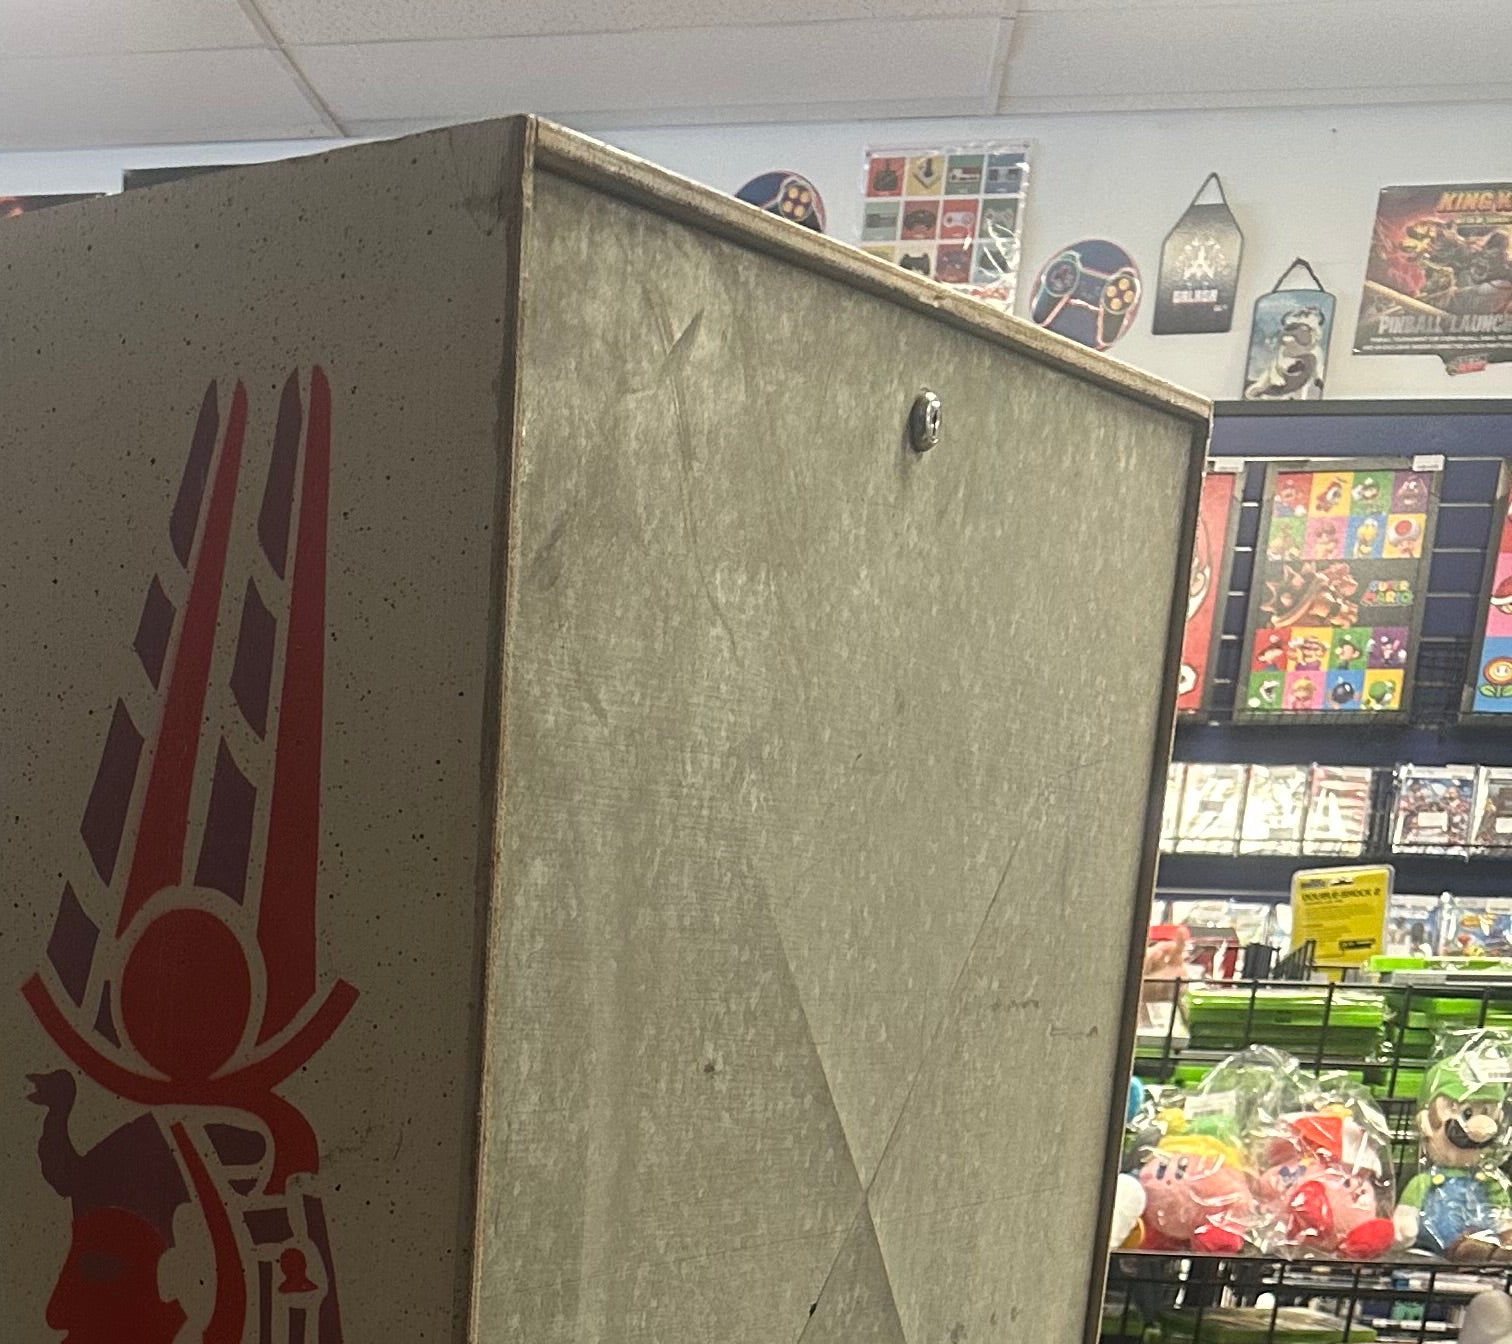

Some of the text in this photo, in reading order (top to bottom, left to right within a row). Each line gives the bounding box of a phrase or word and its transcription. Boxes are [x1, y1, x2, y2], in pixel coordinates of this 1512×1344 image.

[1437, 191, 1493, 214] KING
[1378, 315, 1443, 335] PINBALL
[1360, 590, 1415, 607] MARIO
